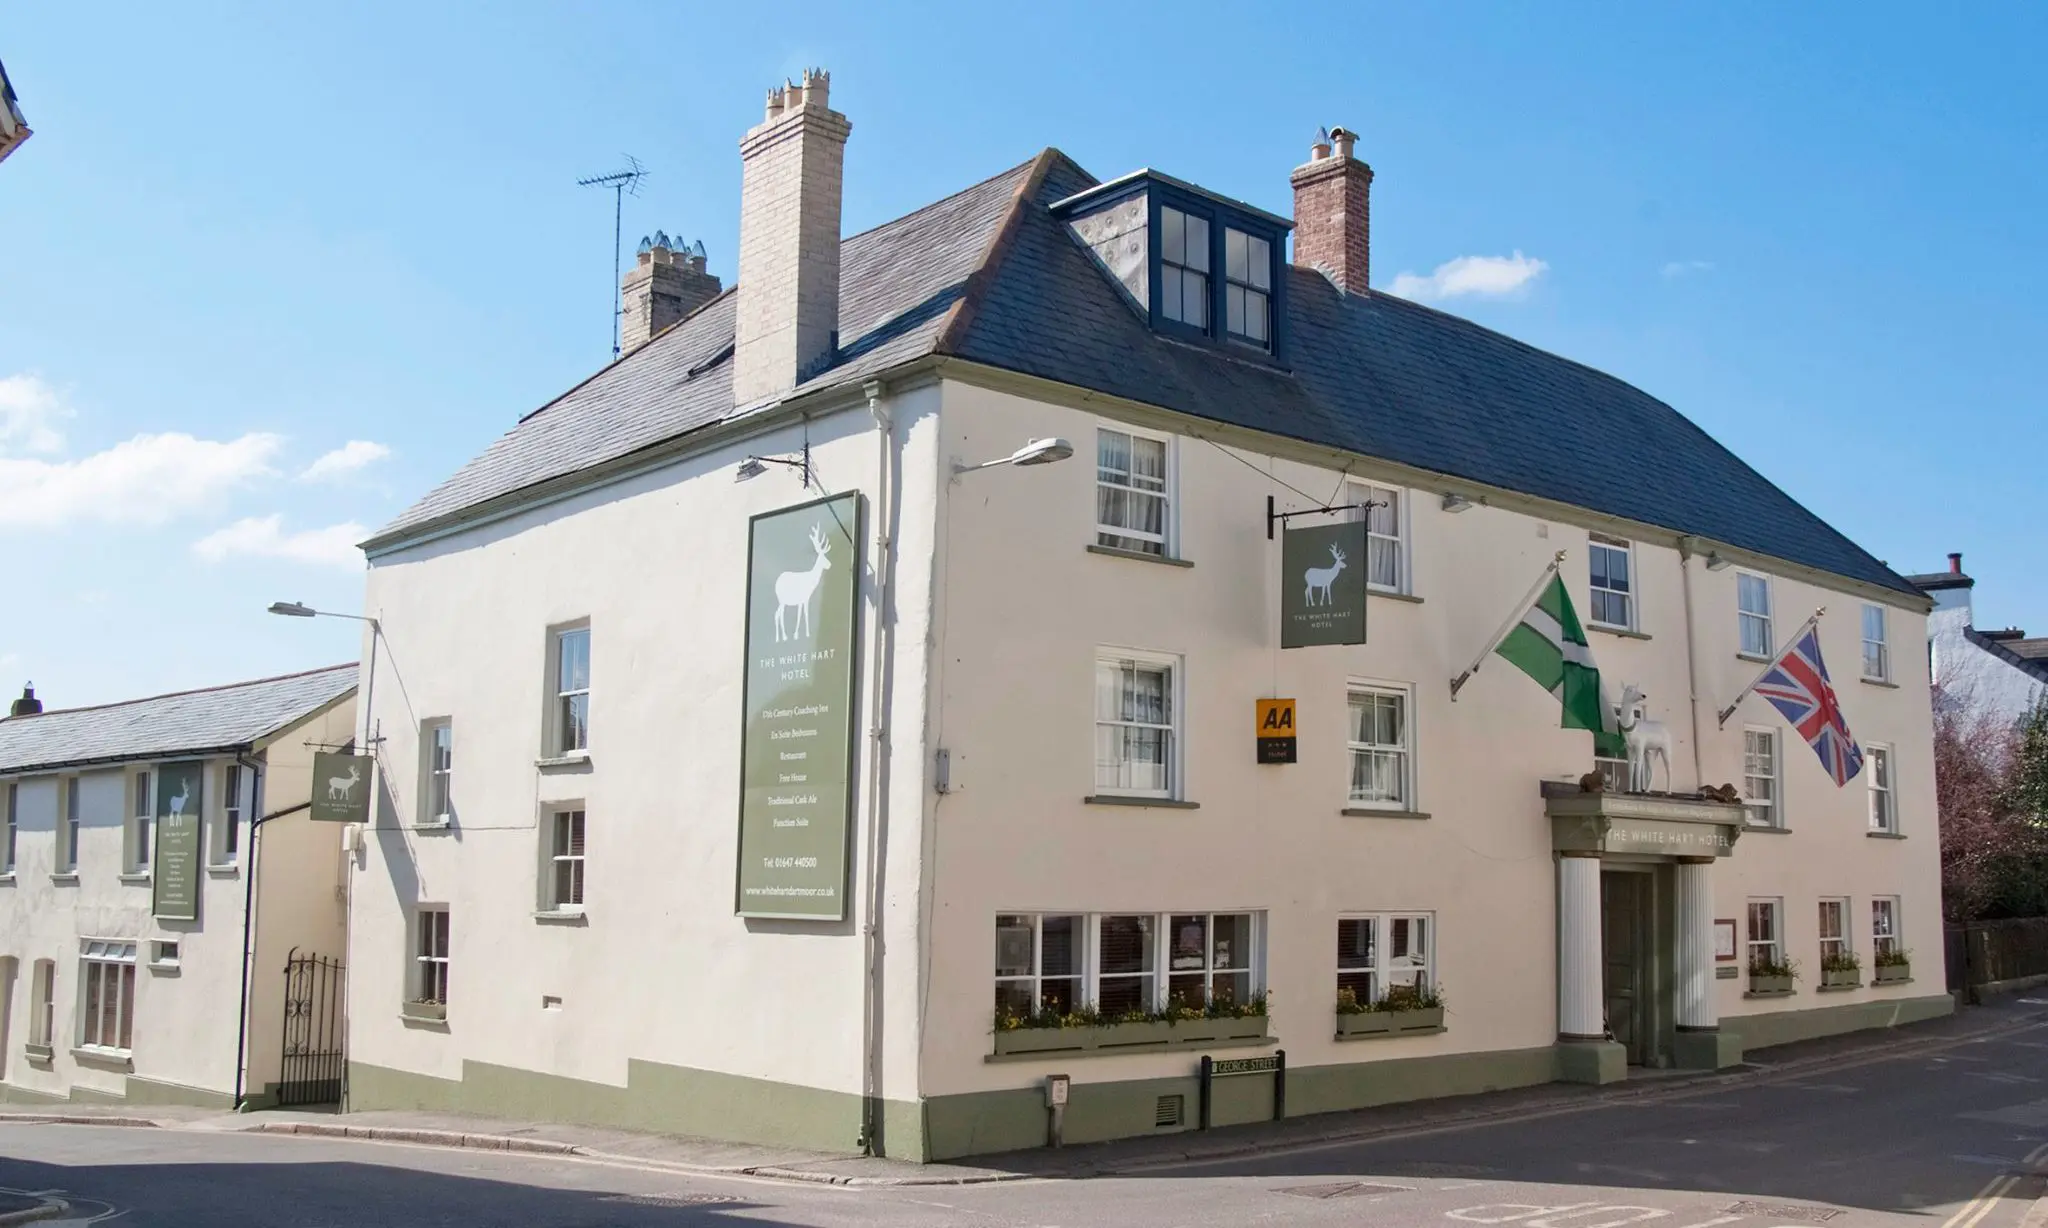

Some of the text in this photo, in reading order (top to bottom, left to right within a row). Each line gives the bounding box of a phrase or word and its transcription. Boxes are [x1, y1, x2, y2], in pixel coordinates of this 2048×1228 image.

[760, 648, 835, 669] THE WHITE HART
[781, 668, 810, 681] HOTEL
[1263, 707, 1292, 729] AA
[1631, 830, 1665, 843] WHITE
[1668, 831, 1695, 845] HART
[1699, 833, 1730, 847] HOTEL
[1219, 1057, 1277, 1073] GEORGE STREET
